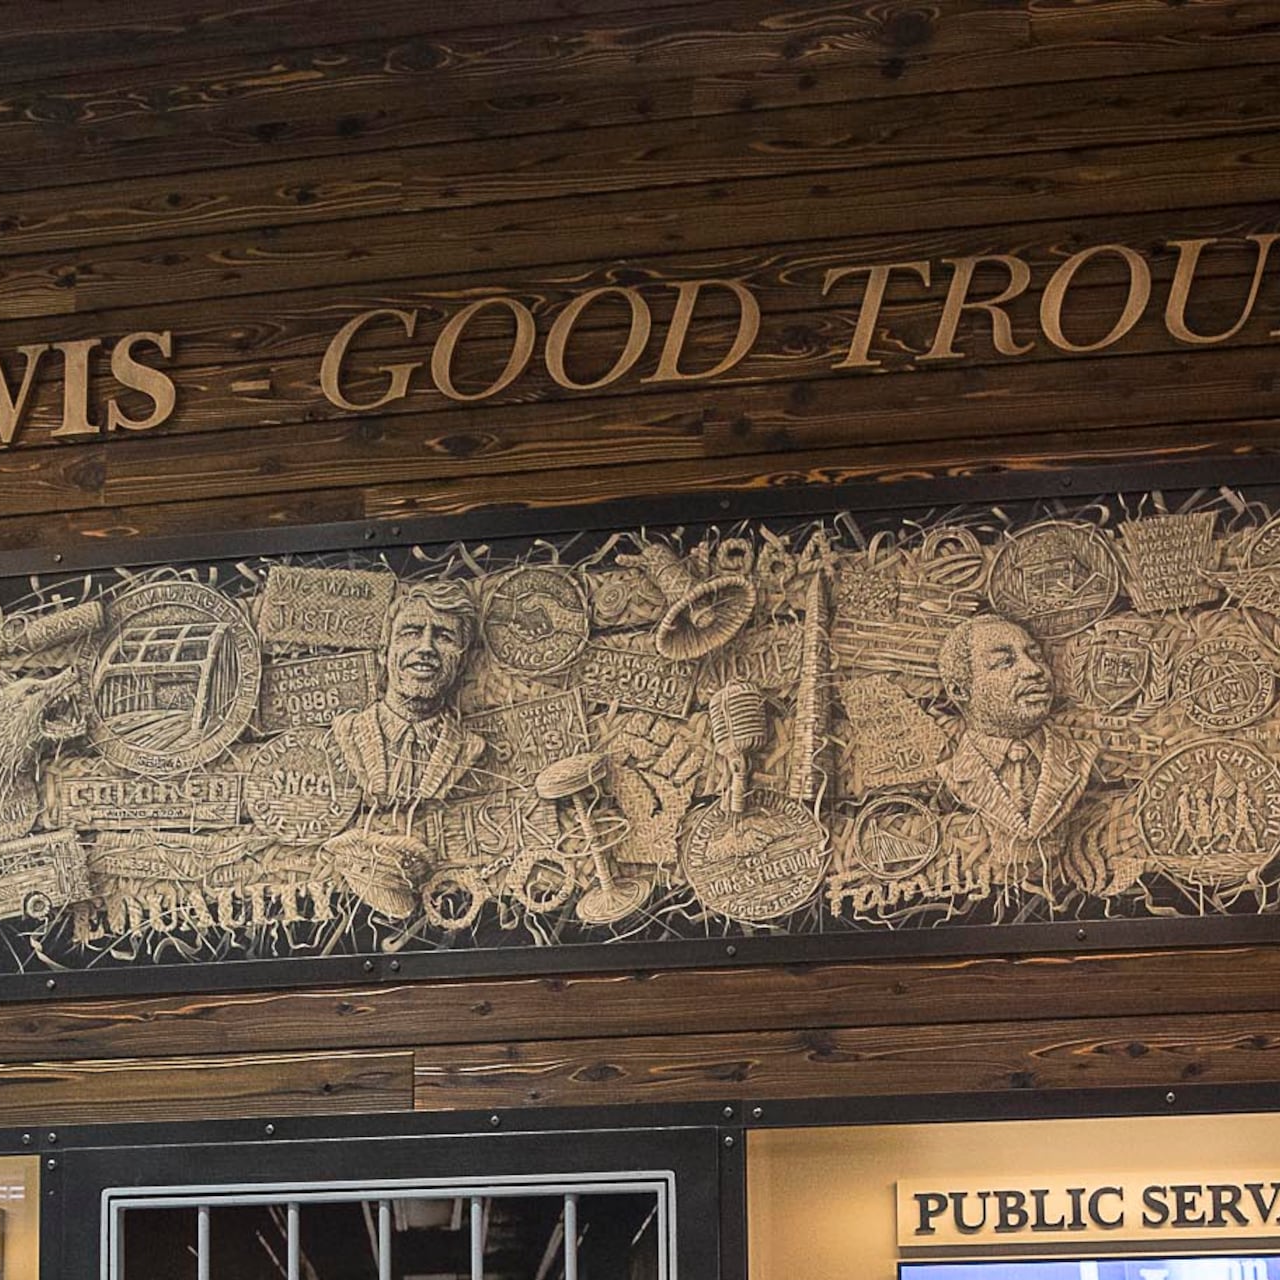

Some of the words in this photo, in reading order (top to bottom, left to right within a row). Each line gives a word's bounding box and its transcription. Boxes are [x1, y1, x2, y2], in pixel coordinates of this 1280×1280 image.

[319, 278, 761, 412] GOOD
[501, 644, 557, 665] SNCC
[273, 767, 330, 796] SNCC
[1152, 760, 1188, 800] CIVIL
[1195, 748, 1266, 780] RIGHTS
[825, 852, 992, 917] Family
[913, 1185, 1124, 1236] PUBLIC
